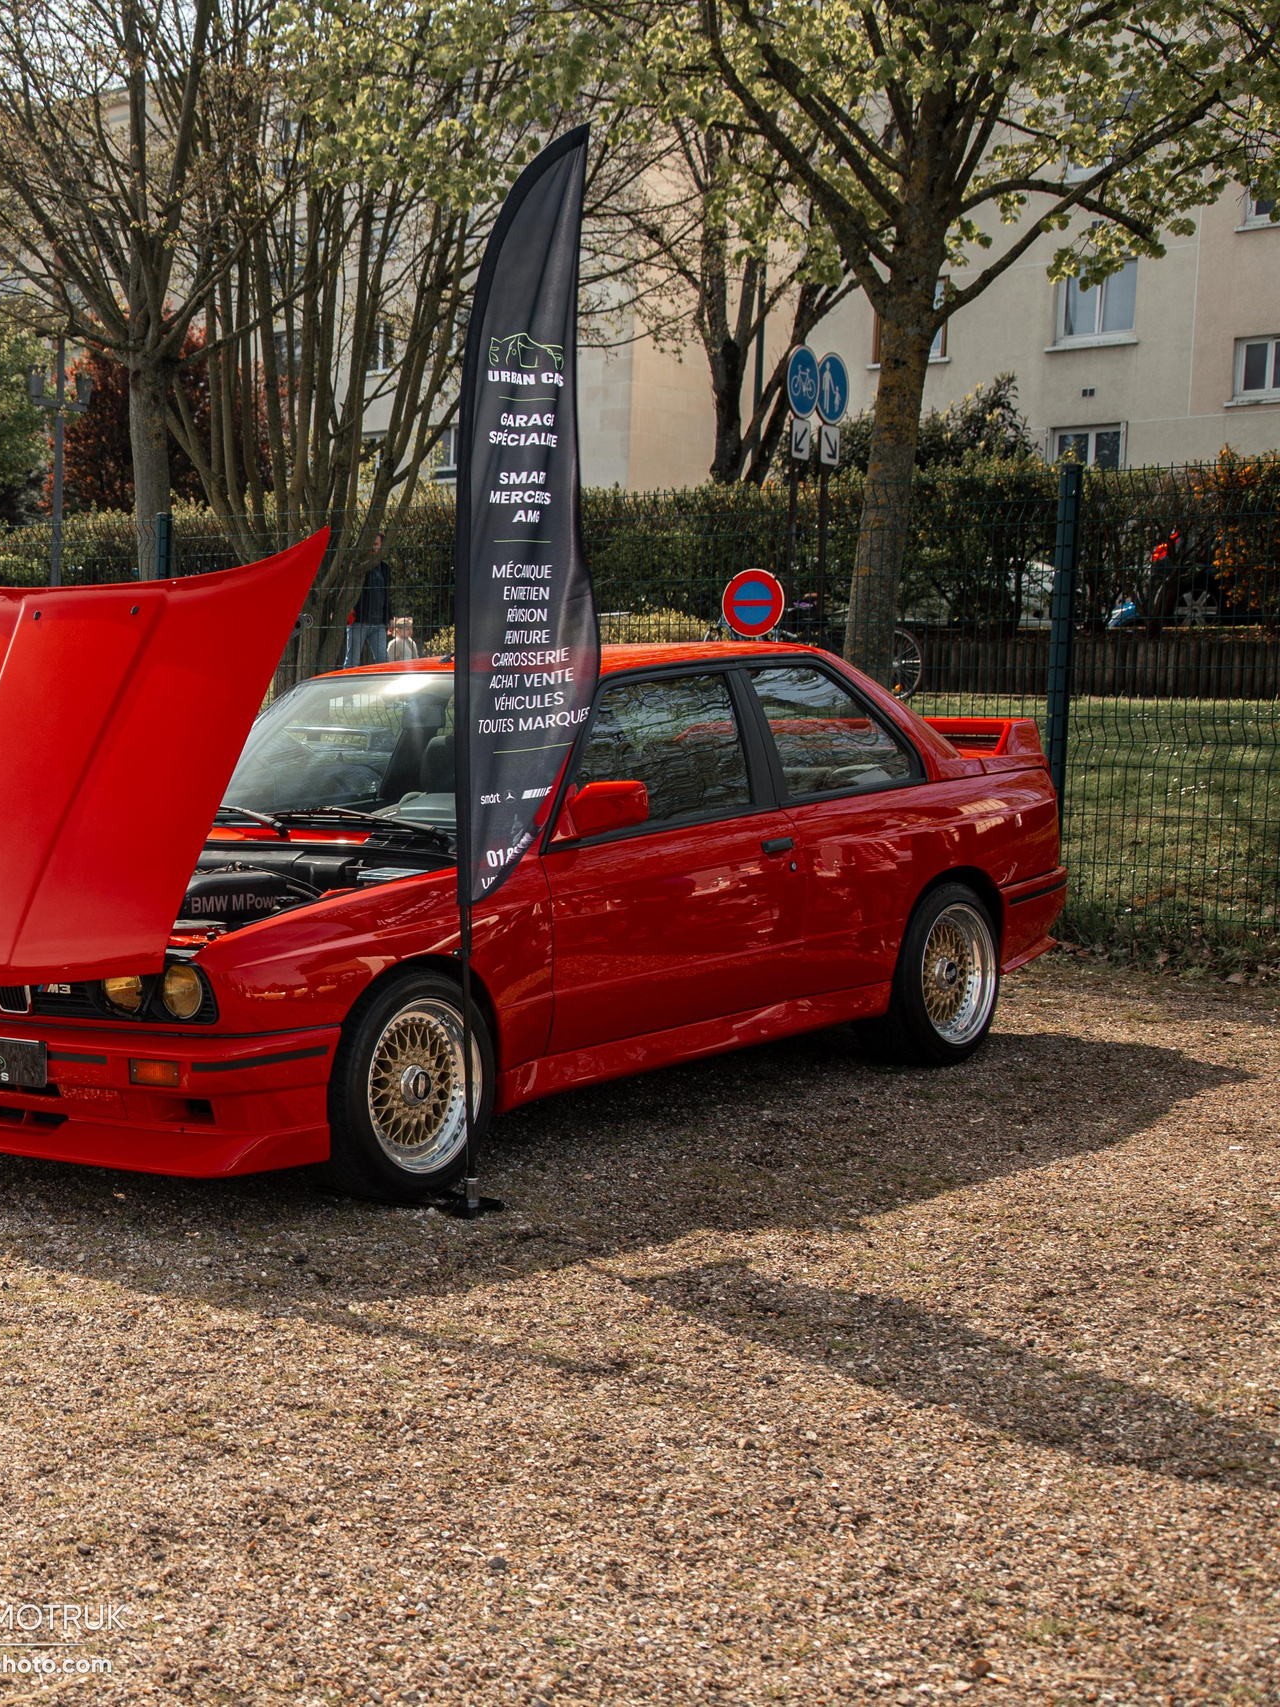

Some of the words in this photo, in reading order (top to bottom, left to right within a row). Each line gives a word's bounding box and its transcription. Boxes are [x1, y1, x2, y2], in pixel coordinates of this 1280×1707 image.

[488, 370, 535, 385] URBAN
[507, 605, 547, 623] RÉVISION
[491, 647, 570, 667] CARROSSERIE
[489, 674, 520, 689] ACHAT
[523, 668, 574, 687] VENTE
[494, 691, 564, 711] VÉHICULES
[478, 719, 514, 734] TOUTES
[519, 707, 590, 731] MARQUES
[191, 895, 229, 914] BMW
[232, 894, 245, 911] M
[47, 983, 71, 994] M3
